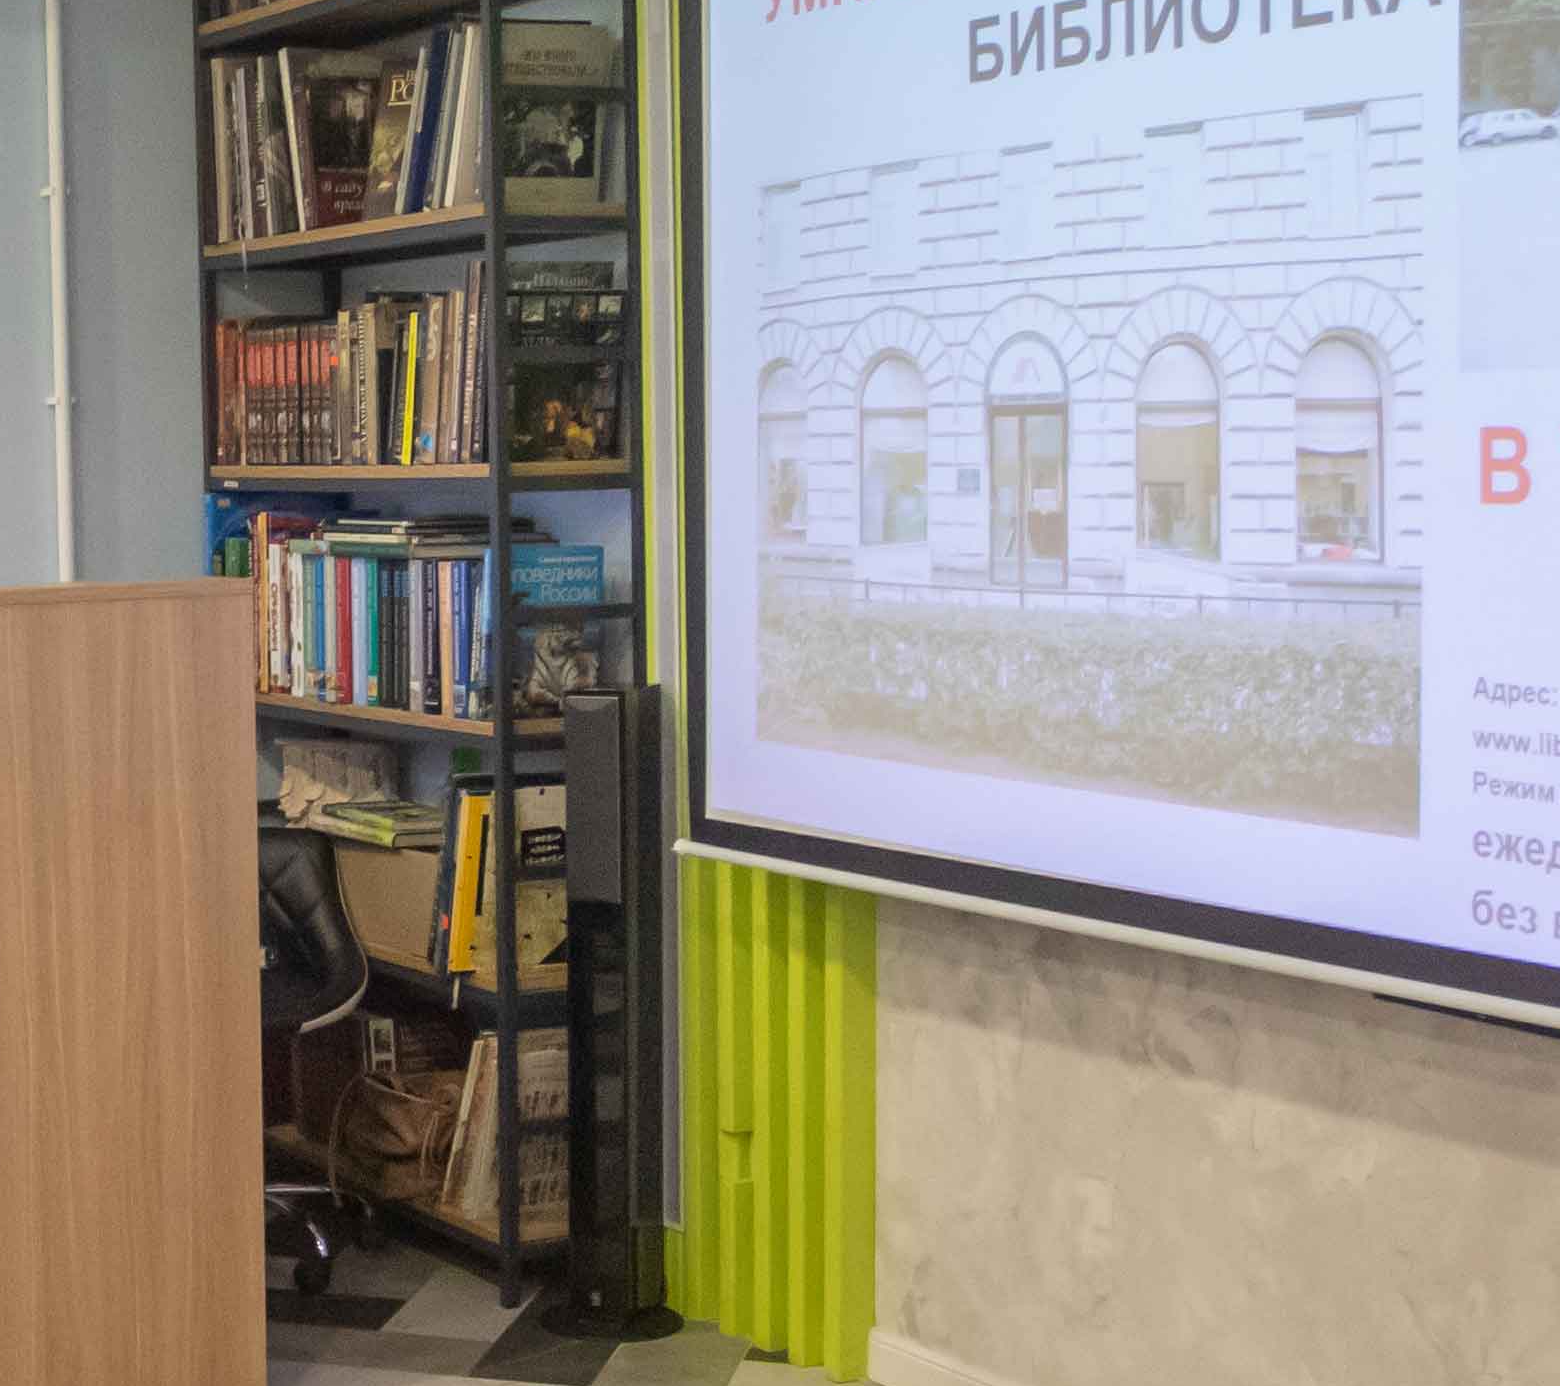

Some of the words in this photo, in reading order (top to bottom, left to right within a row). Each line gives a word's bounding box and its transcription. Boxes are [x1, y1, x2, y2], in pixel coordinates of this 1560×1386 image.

[1480, 426, 1531, 504] В
[1473, 676, 1558, 708] Адрес:
[1473, 773, 1555, 805] Режим
[1472, 890, 1538, 934] без
